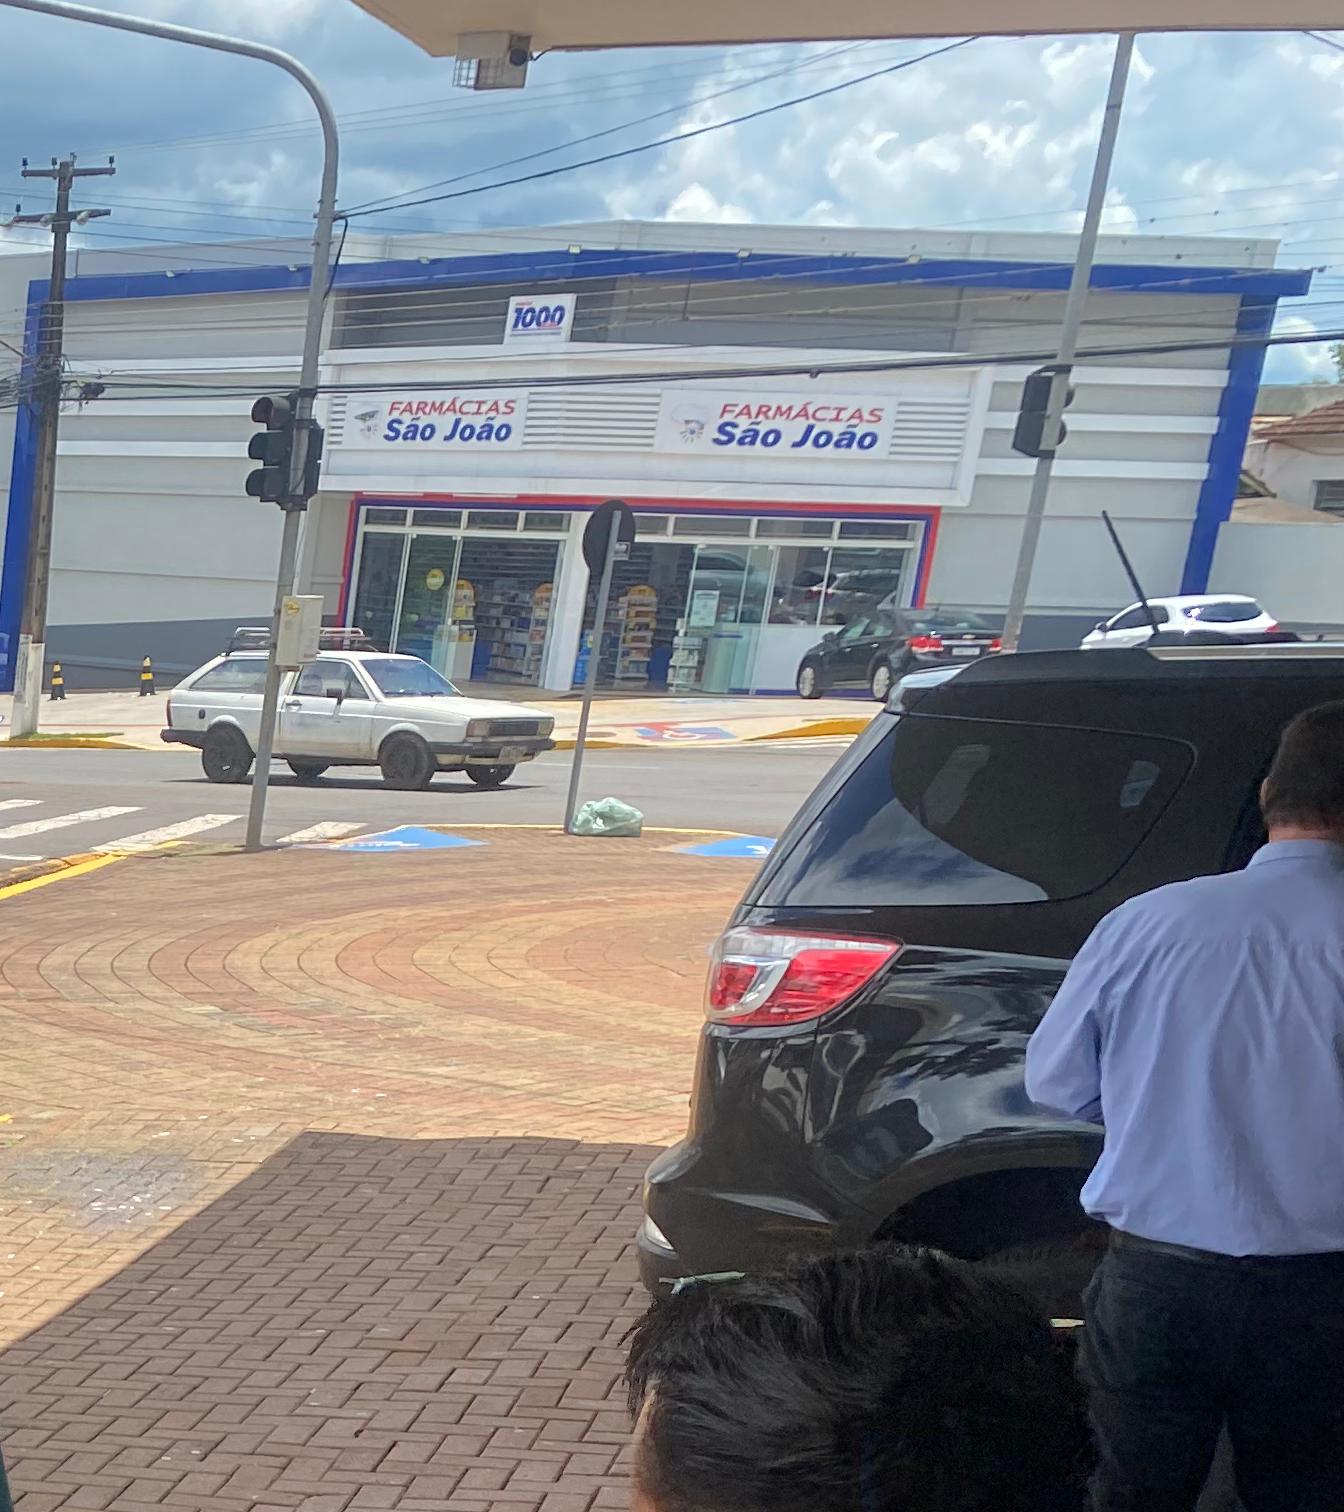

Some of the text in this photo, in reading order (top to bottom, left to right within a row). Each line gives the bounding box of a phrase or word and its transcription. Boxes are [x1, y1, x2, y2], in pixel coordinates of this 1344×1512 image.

[513, 305, 565, 329] 1000
[388, 397, 516, 416] FARMÁCIAS
[719, 401, 885, 423] FARMÁCIAS
[383, 416, 512, 442] São João
[712, 421, 878, 450] São João
